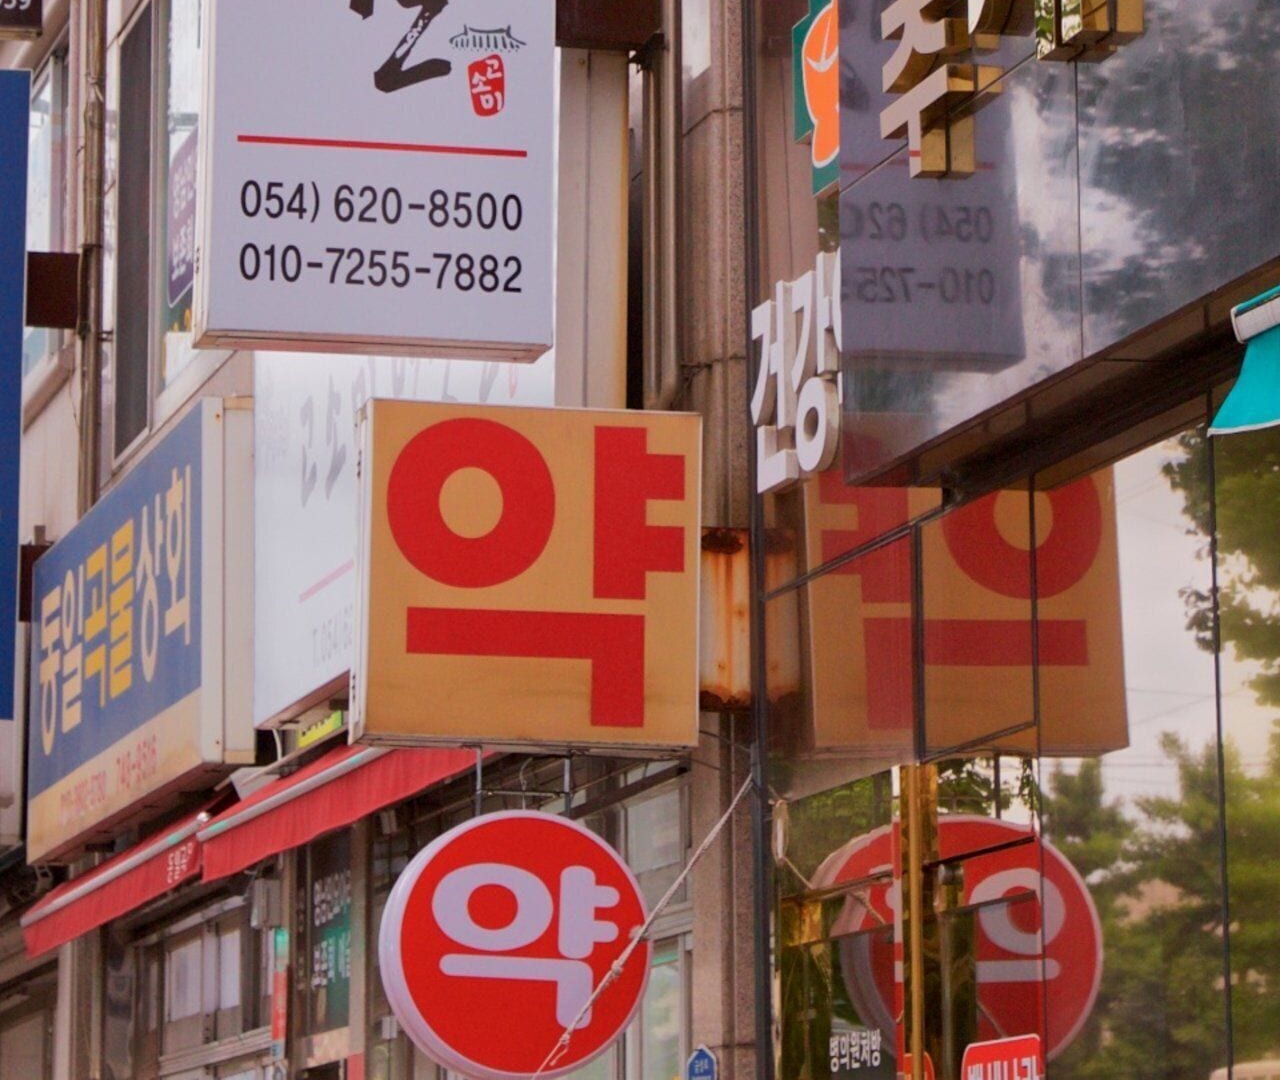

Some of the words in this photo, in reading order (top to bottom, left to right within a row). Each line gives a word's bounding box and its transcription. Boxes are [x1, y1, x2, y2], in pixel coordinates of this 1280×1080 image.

[238, 242, 523, 294] 010-7255-7882
[239, 179, 320, 223] 054)
[333, 184, 523, 231] 620-8500
[752, 248, 841, 494] 건강
[386, 417, 685, 728] 약
[432, 862, 620, 1030] 약
